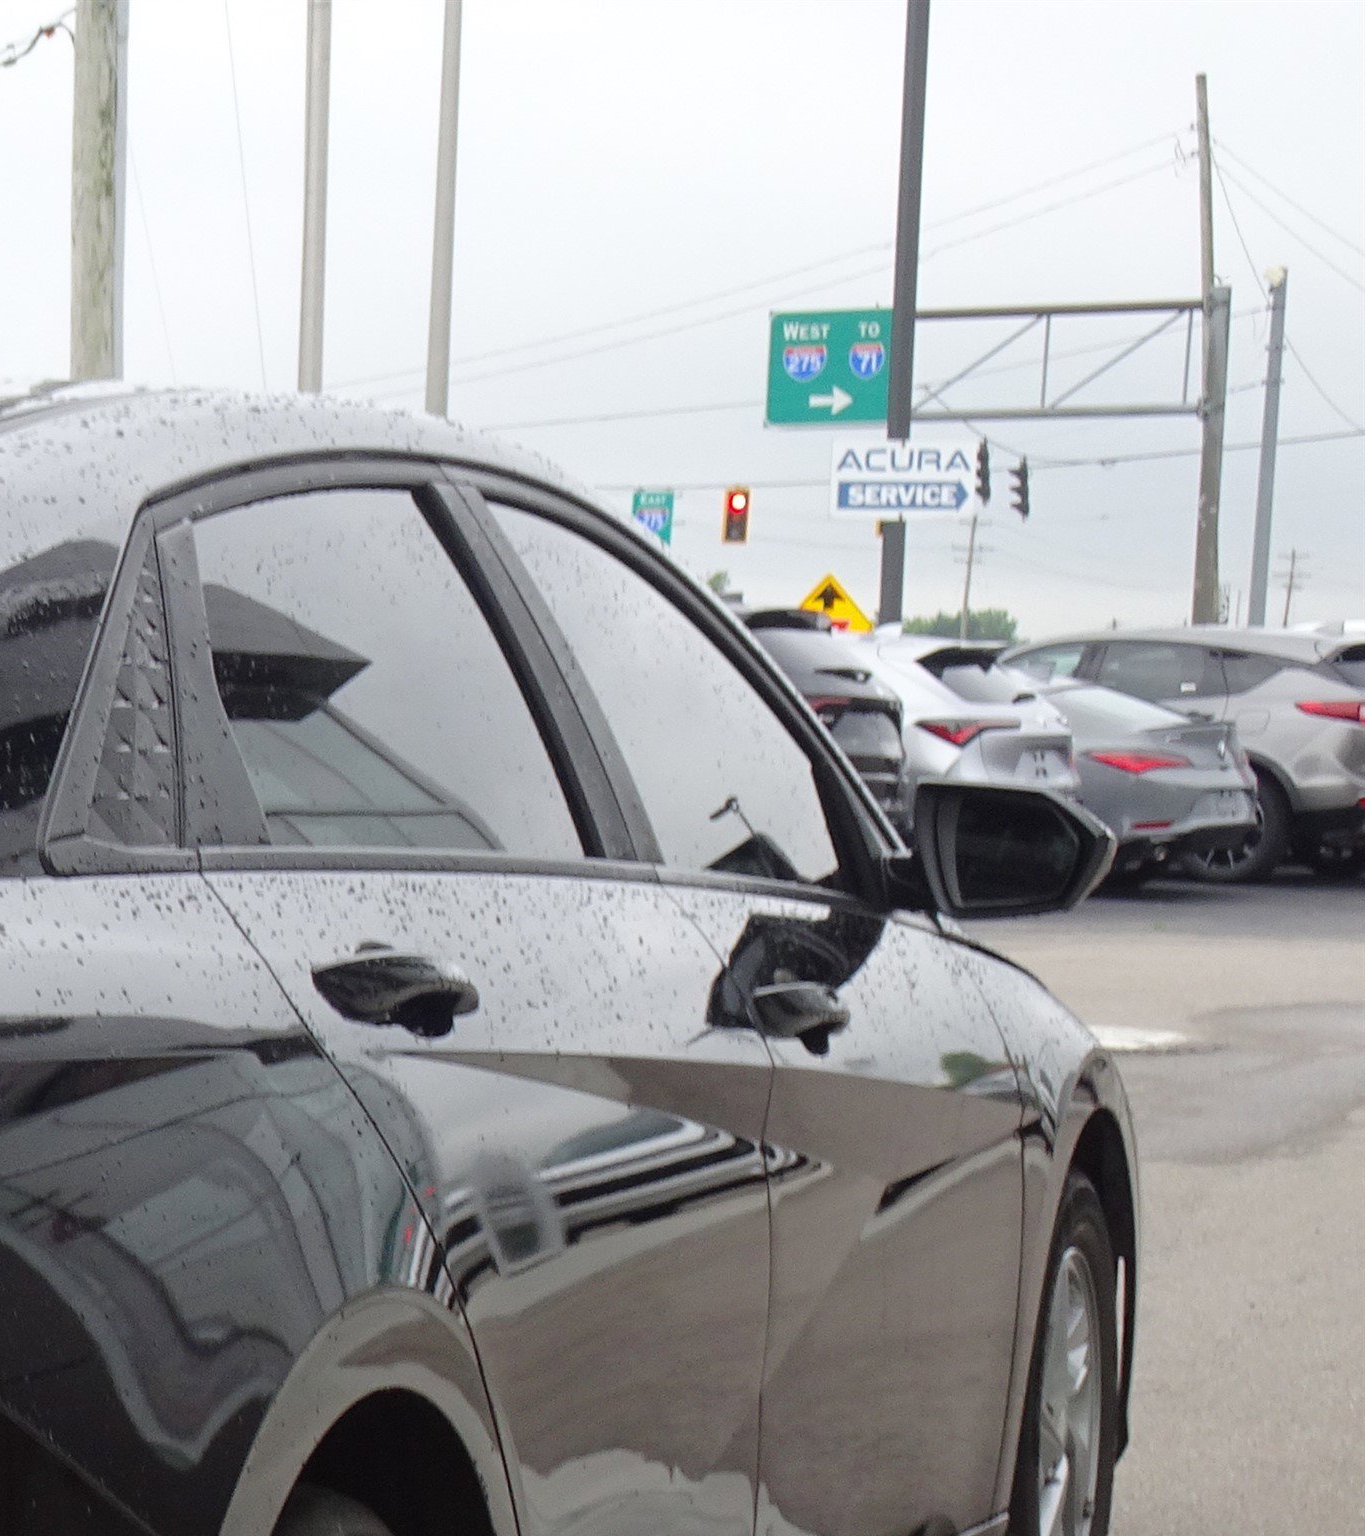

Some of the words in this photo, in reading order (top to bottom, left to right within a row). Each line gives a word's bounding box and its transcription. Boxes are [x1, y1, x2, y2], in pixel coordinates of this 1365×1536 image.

[783, 321, 829, 341] WEST
[858, 321, 881, 339] TO
[858, 351, 877, 374] 71
[837, 447, 971, 472] ACURA
[847, 483, 959, 508] SERVICE
